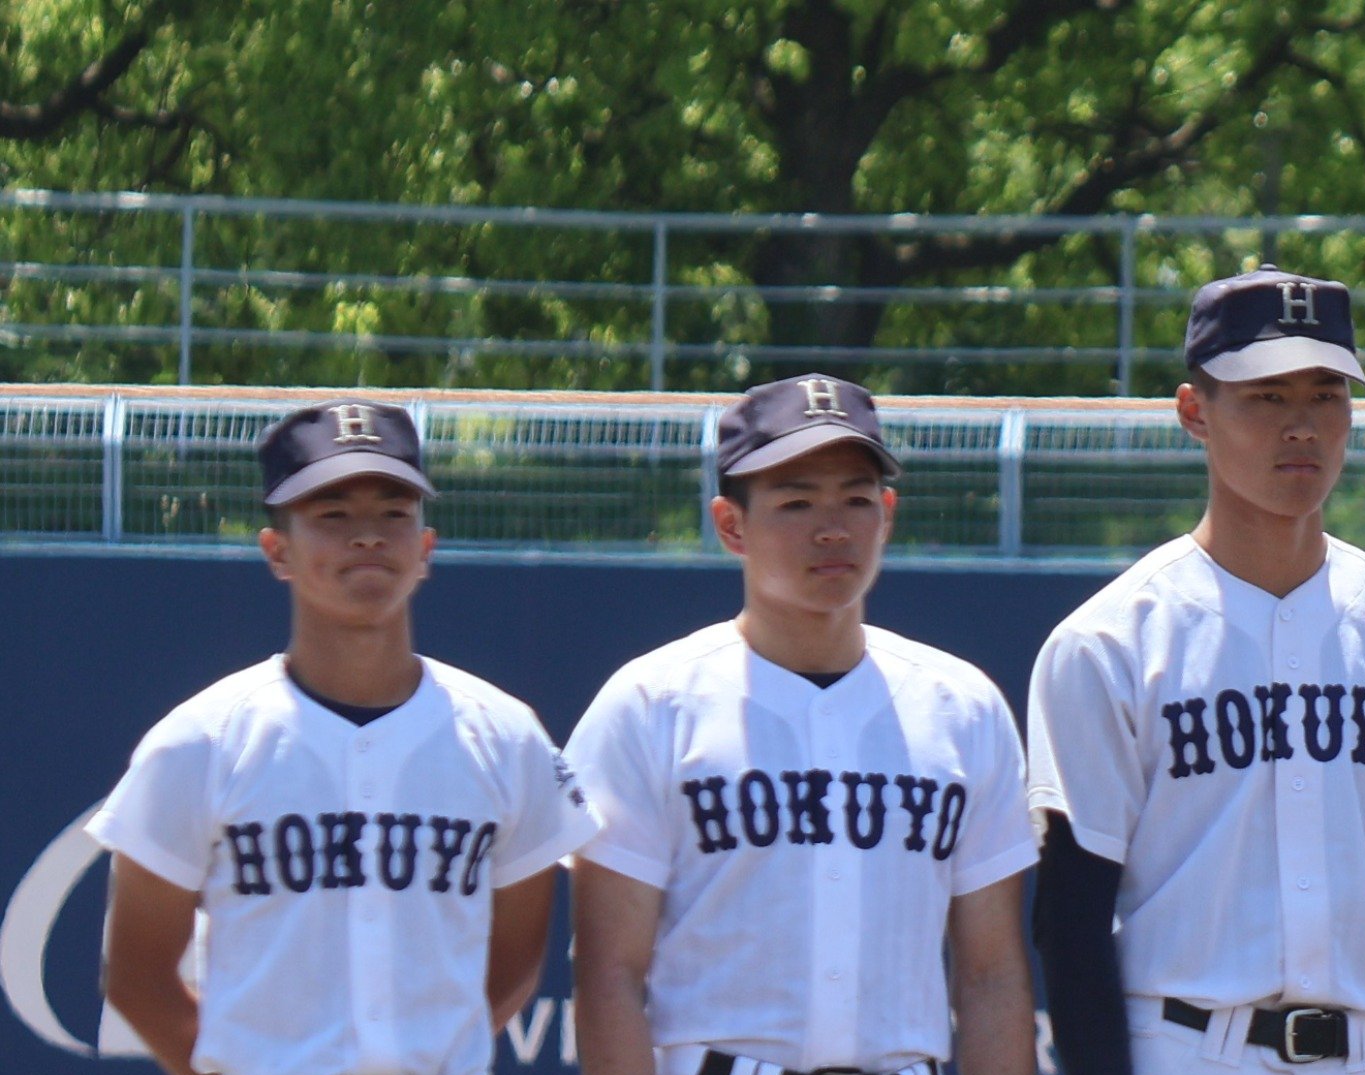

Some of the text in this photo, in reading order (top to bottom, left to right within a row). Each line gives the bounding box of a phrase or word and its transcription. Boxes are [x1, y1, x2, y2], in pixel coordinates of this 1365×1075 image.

[1276, 282, 1320, 325] H
[797, 379, 848, 418] H
[328, 404, 381, 444] H
[682, 769, 966, 861] HOKUYO
[222, 811, 498, 897] HOKUYO
